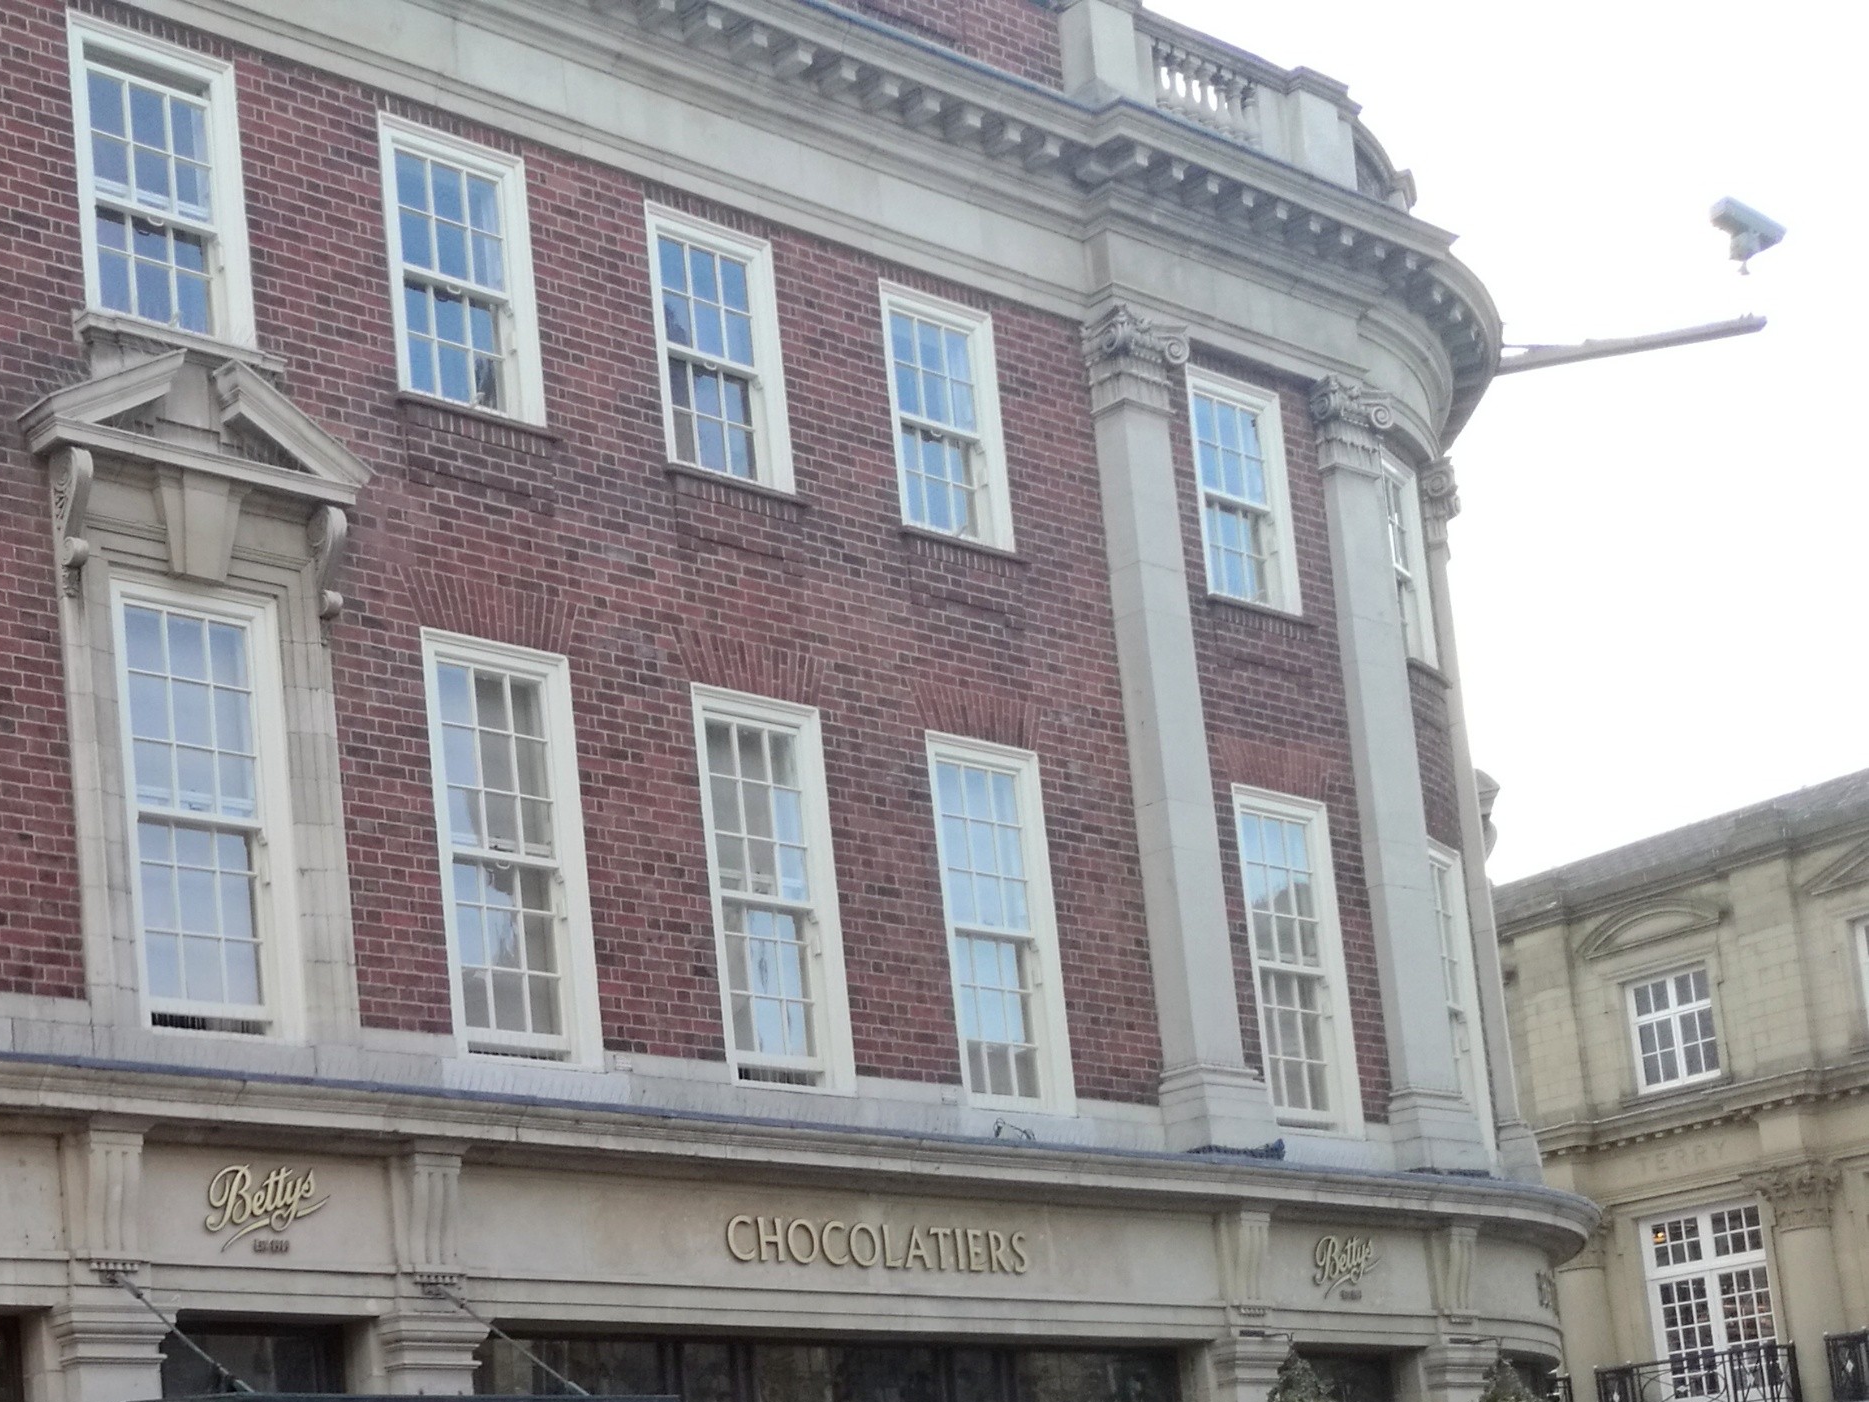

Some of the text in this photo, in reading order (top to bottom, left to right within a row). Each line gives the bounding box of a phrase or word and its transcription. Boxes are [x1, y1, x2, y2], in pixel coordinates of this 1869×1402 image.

[205, 1164, 318, 1232] Bettys
[726, 1214, 1028, 1275] CHOCOLATIERS
[1313, 1234, 1373, 1285] Bettys
